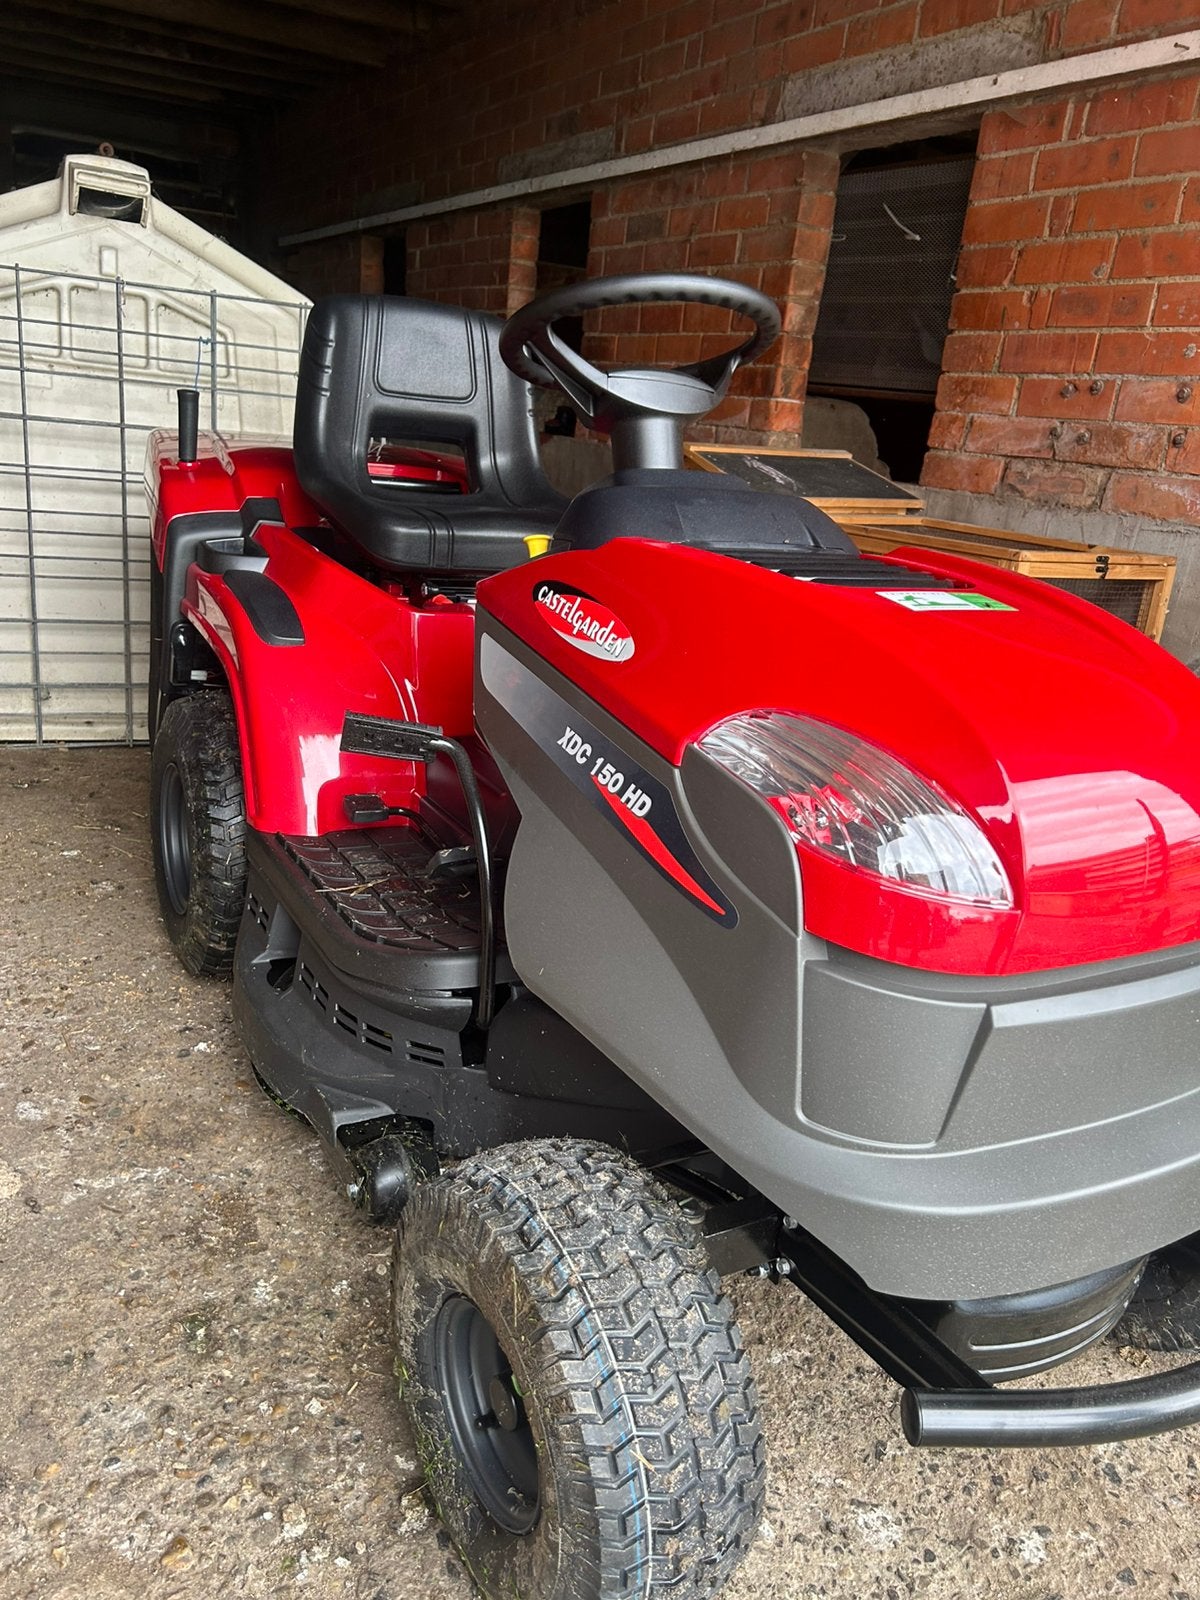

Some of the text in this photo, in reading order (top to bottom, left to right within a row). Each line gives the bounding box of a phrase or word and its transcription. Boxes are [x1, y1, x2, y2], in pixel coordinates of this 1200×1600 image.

[556, 725, 653, 818] XDC 150 HD
